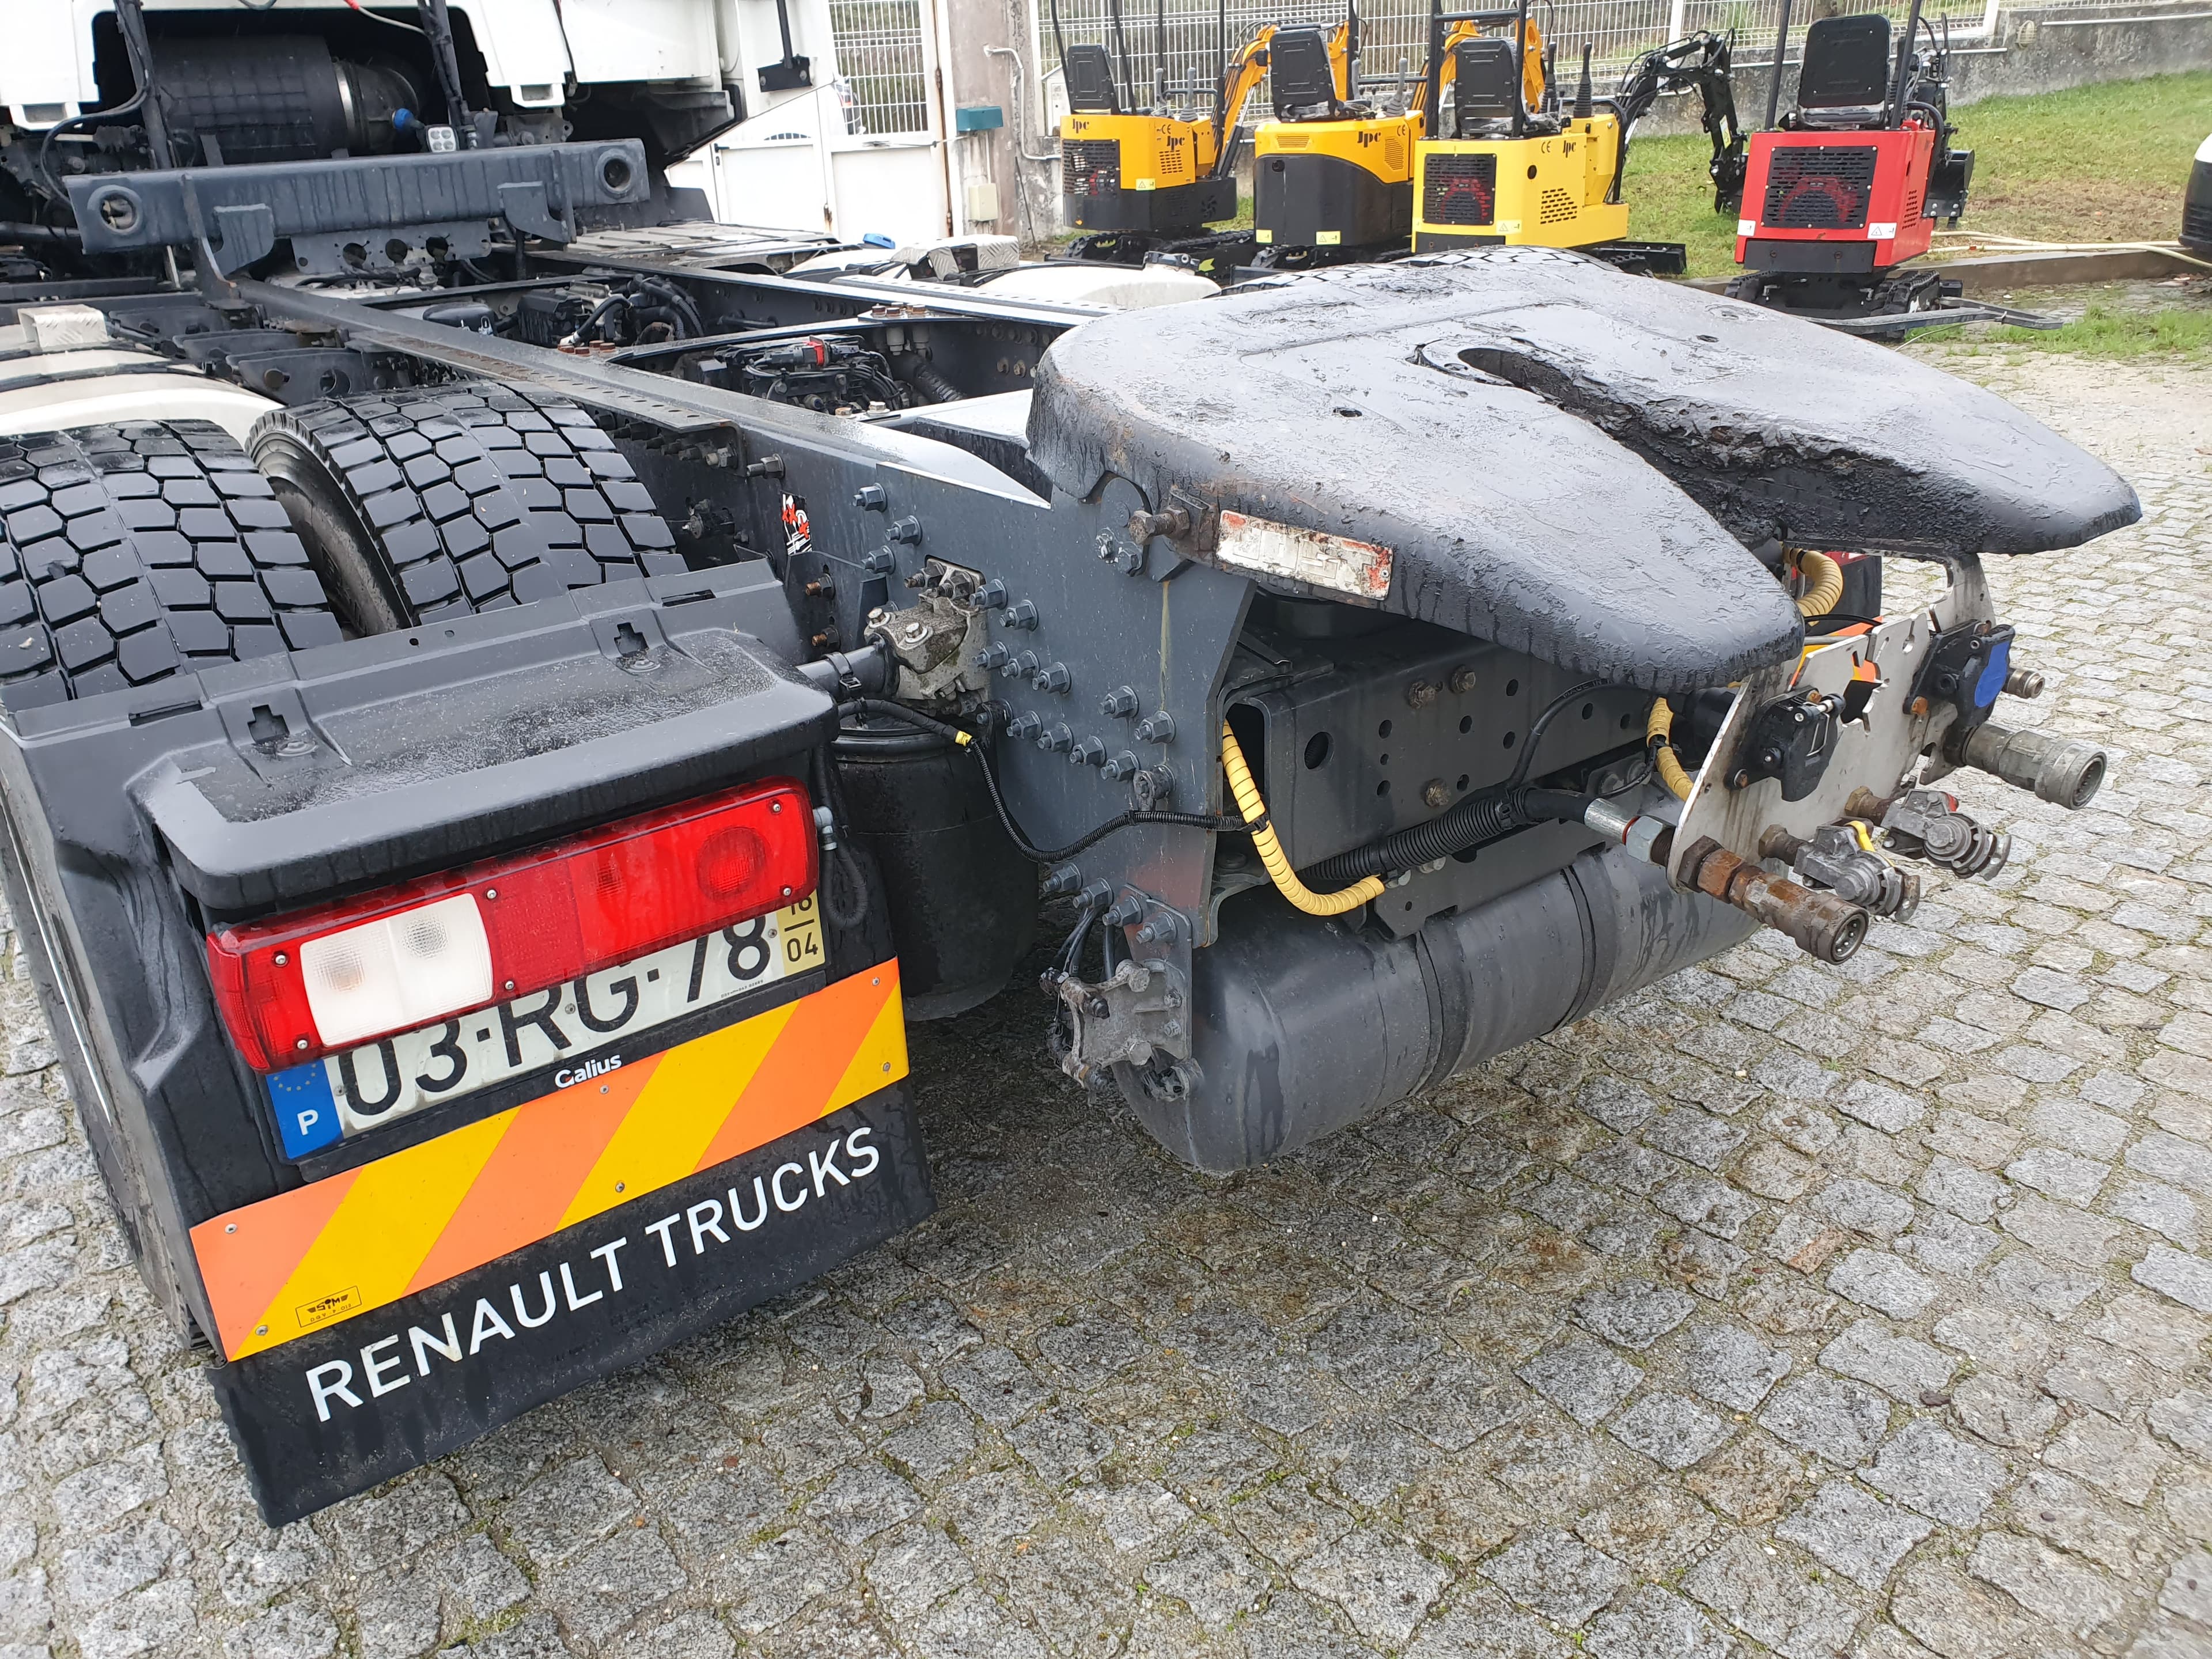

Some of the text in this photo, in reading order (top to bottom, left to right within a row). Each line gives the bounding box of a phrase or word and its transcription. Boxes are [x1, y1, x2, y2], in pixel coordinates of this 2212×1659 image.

[787, 931, 819, 963] 04
[555, 1055, 622, 1088] Galius
[297, 1109, 319, 1136] P
[305, 1127, 880, 1422] RENAULT TRUCKS
